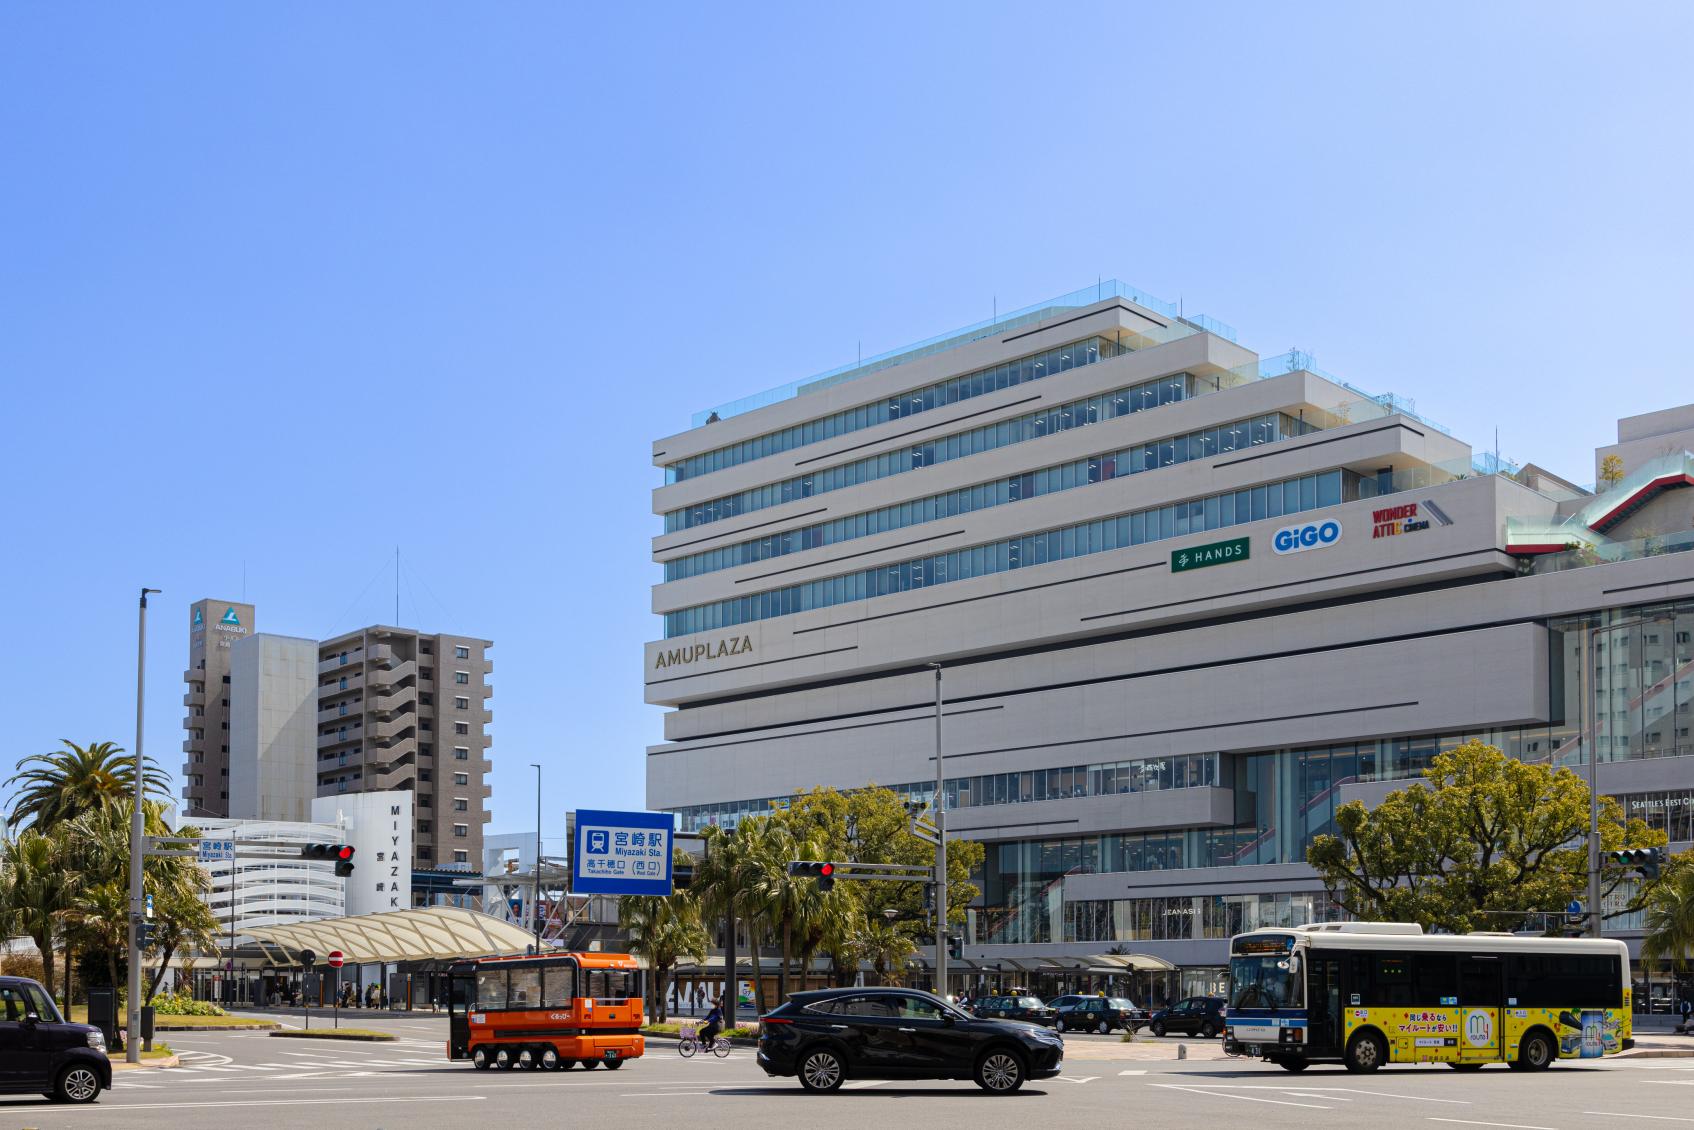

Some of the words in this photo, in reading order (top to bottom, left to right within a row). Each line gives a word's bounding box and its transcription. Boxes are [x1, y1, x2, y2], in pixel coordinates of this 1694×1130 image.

[1372, 504, 1417, 523] WONDER
[1372, 522, 1403, 539] ATTIC
[1404, 519, 1430, 533] CINEMA
[1275, 525, 1338, 550] GiGO
[1196, 545, 1242, 563] HANDS
[655, 635, 753, 669] AMUPLAZA
[202, 841, 233, 851] 宮崎駅
[615, 832, 662, 847] 宮崎駅
[615, 848, 646, 857] Miyazaki
[649, 848, 662, 857] Sta.
[586, 859, 625, 869] 高千穂口
[1409, 1013, 1447, 1022] 同じ乗るなら
